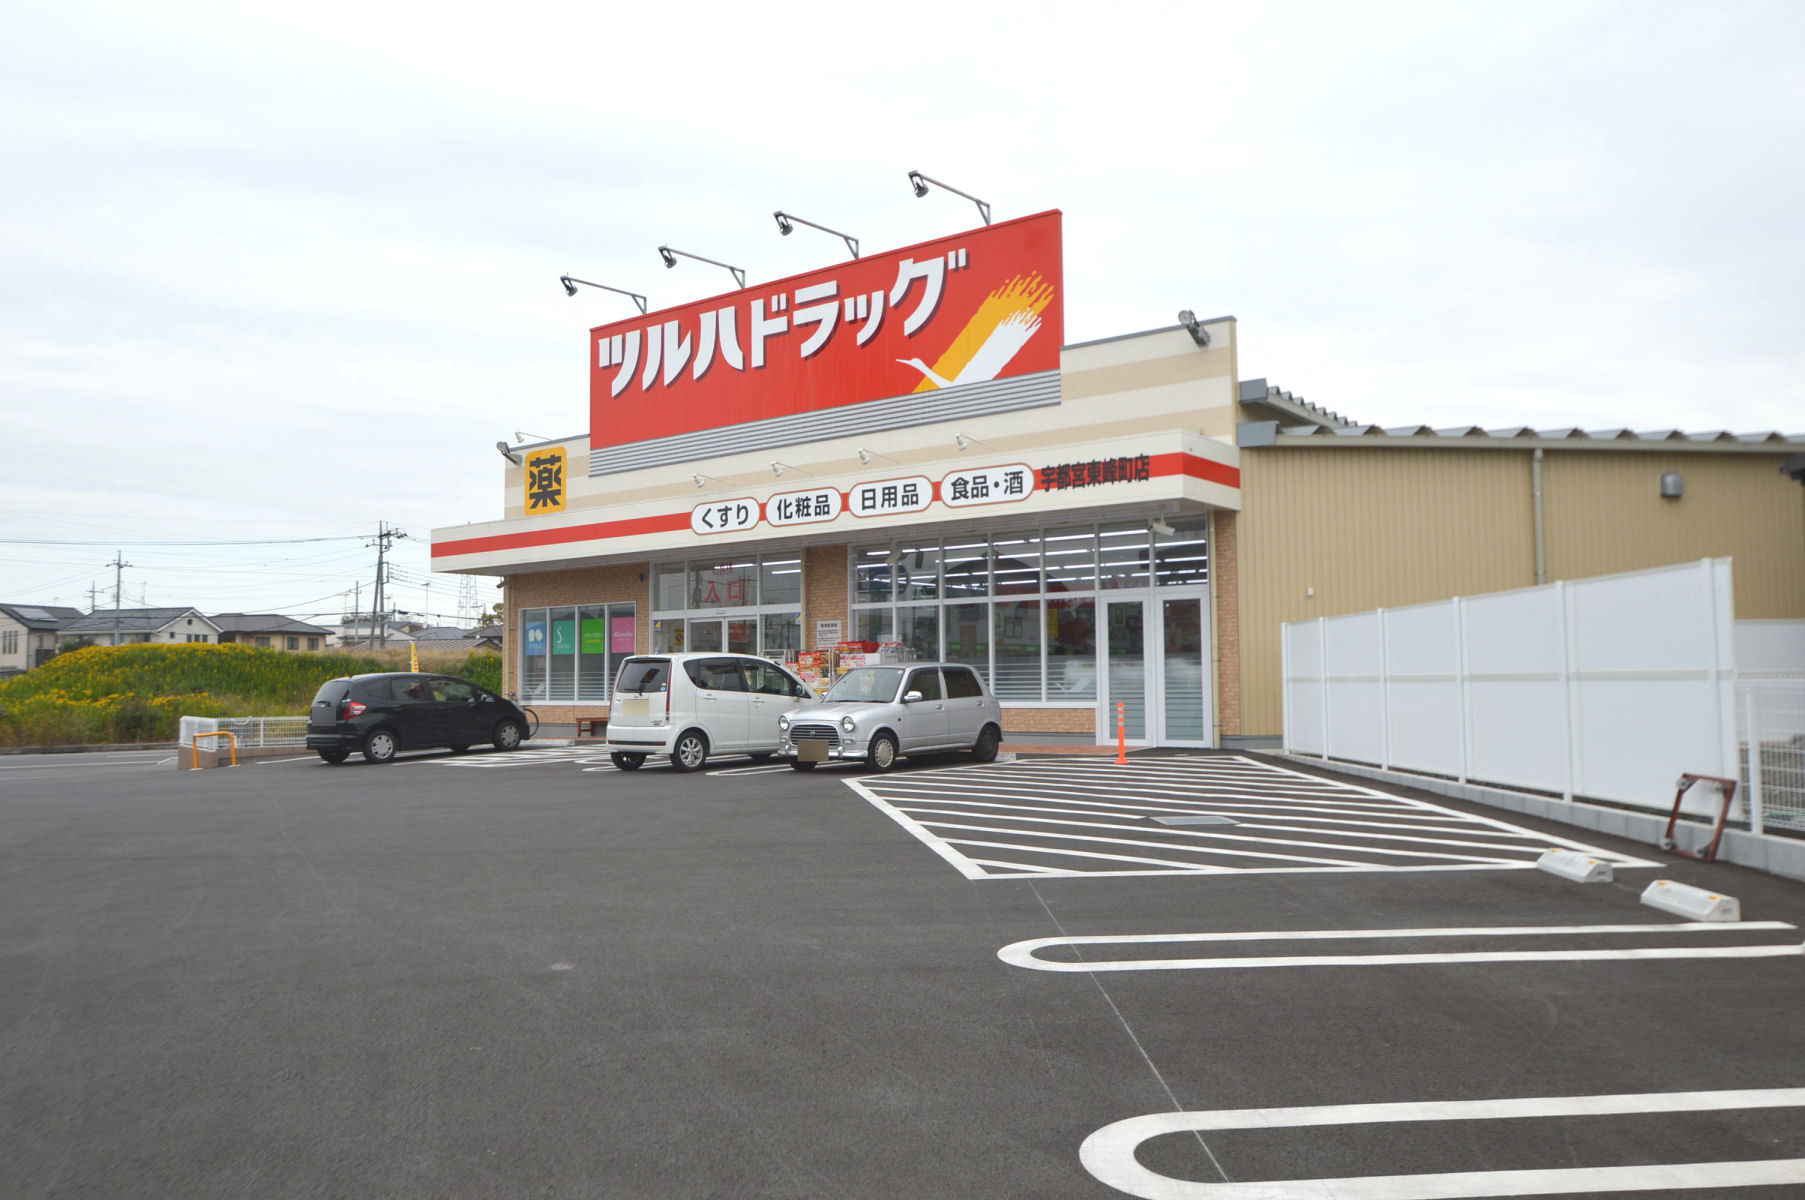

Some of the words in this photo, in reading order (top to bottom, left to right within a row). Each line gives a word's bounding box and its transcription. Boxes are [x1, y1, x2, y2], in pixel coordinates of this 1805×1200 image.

[598, 248, 967, 398] ツルハドラッグ
[529, 454, 562, 509] 薬
[1041, 453, 1150, 492] 宇都宮東峰町店
[777, 494, 830, 521] 化粧品
[861, 483, 919, 511] 日用品
[701, 504, 749, 529] くすり
[704, 579, 743, 603] 入口
